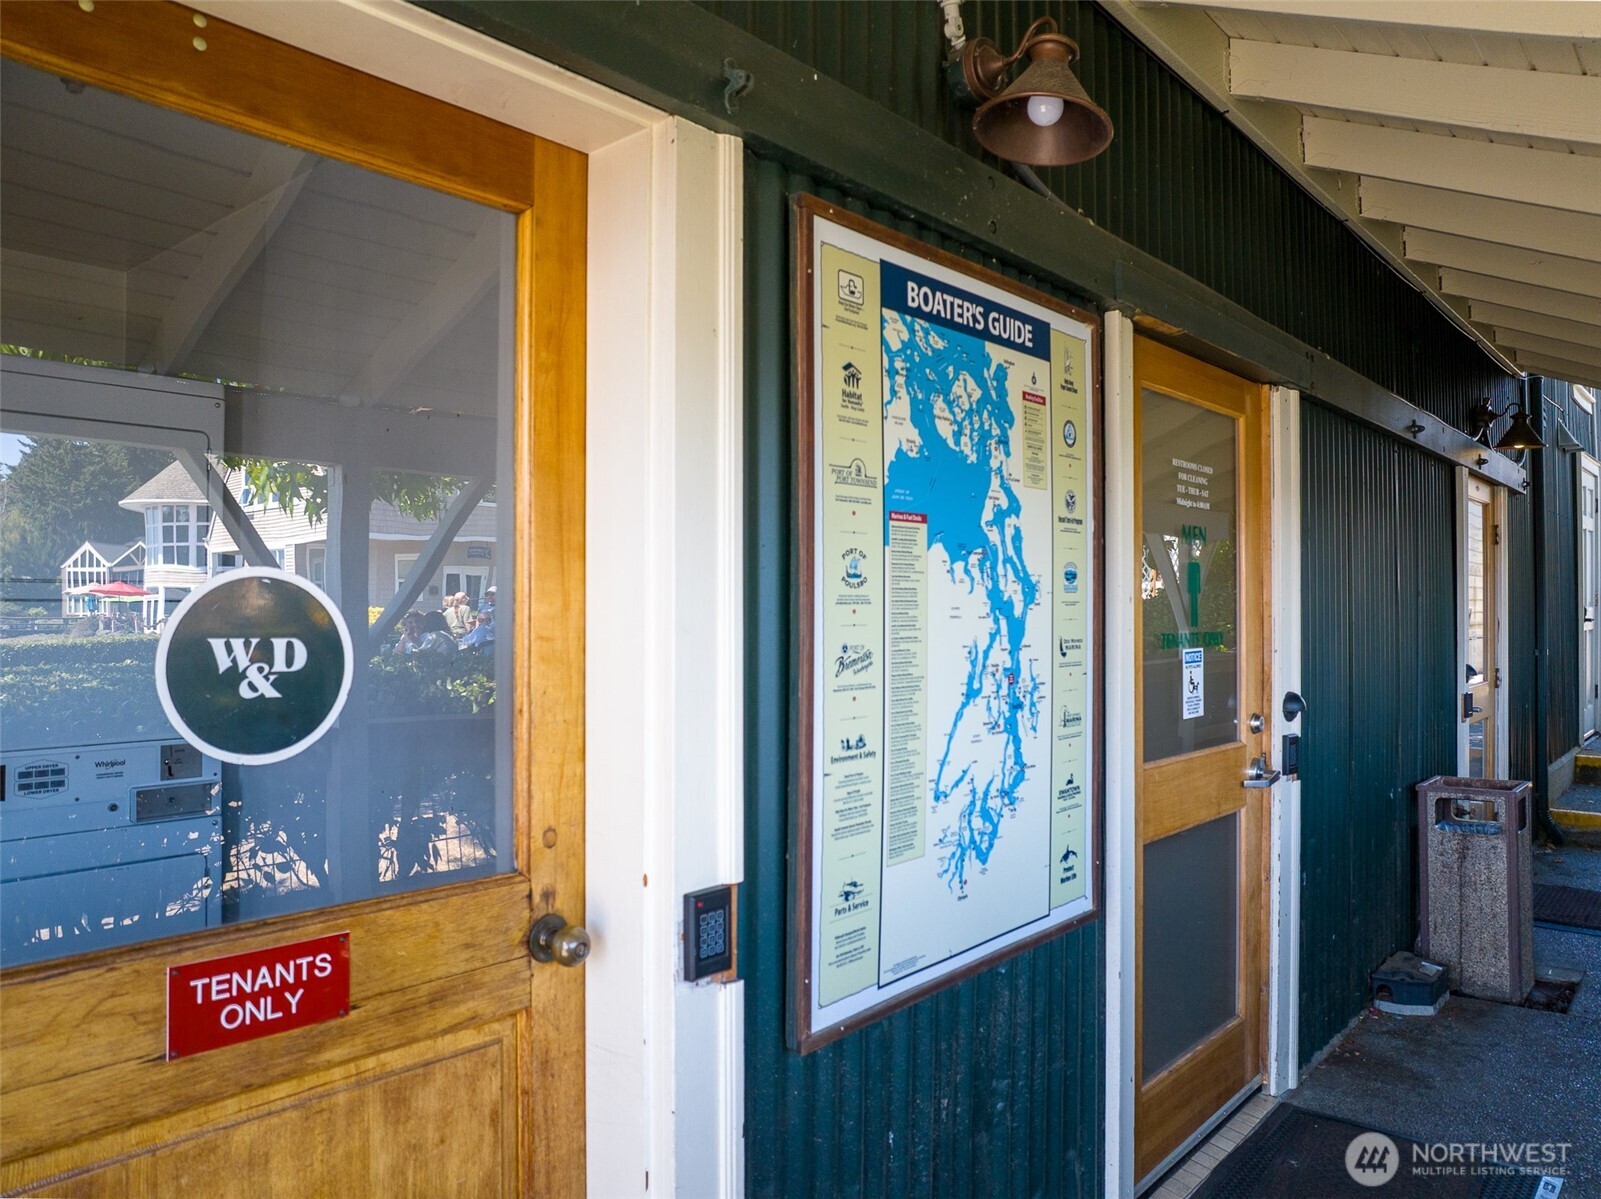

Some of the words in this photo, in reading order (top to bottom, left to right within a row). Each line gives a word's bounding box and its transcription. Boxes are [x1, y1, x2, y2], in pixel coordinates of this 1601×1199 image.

[907, 281, 985, 331] BOATER'S
[988, 311, 1034, 348] GUIDE
[1172, 458, 1198, 471] RESTROOMS
[1197, 464, 1214, 474] CLOSED
[1178, 472, 1188, 481] FOR
[1188, 475, 1208, 486] CLEANING
[1182, 523, 1207, 546] MEN
[841, 547, 858, 560] PORT
[841, 576, 868, 589] POULSBO
[94, 759, 126, 770] Whirlpool
[831, 753, 859, 765] Environment
[863, 750, 876, 759] Safety
[834, 907, 847, 917] Parts
[852, 900, 869, 911] Service
[190, 953, 333, 1004] TENANTS
[220, 988, 304, 1030] ONLY
